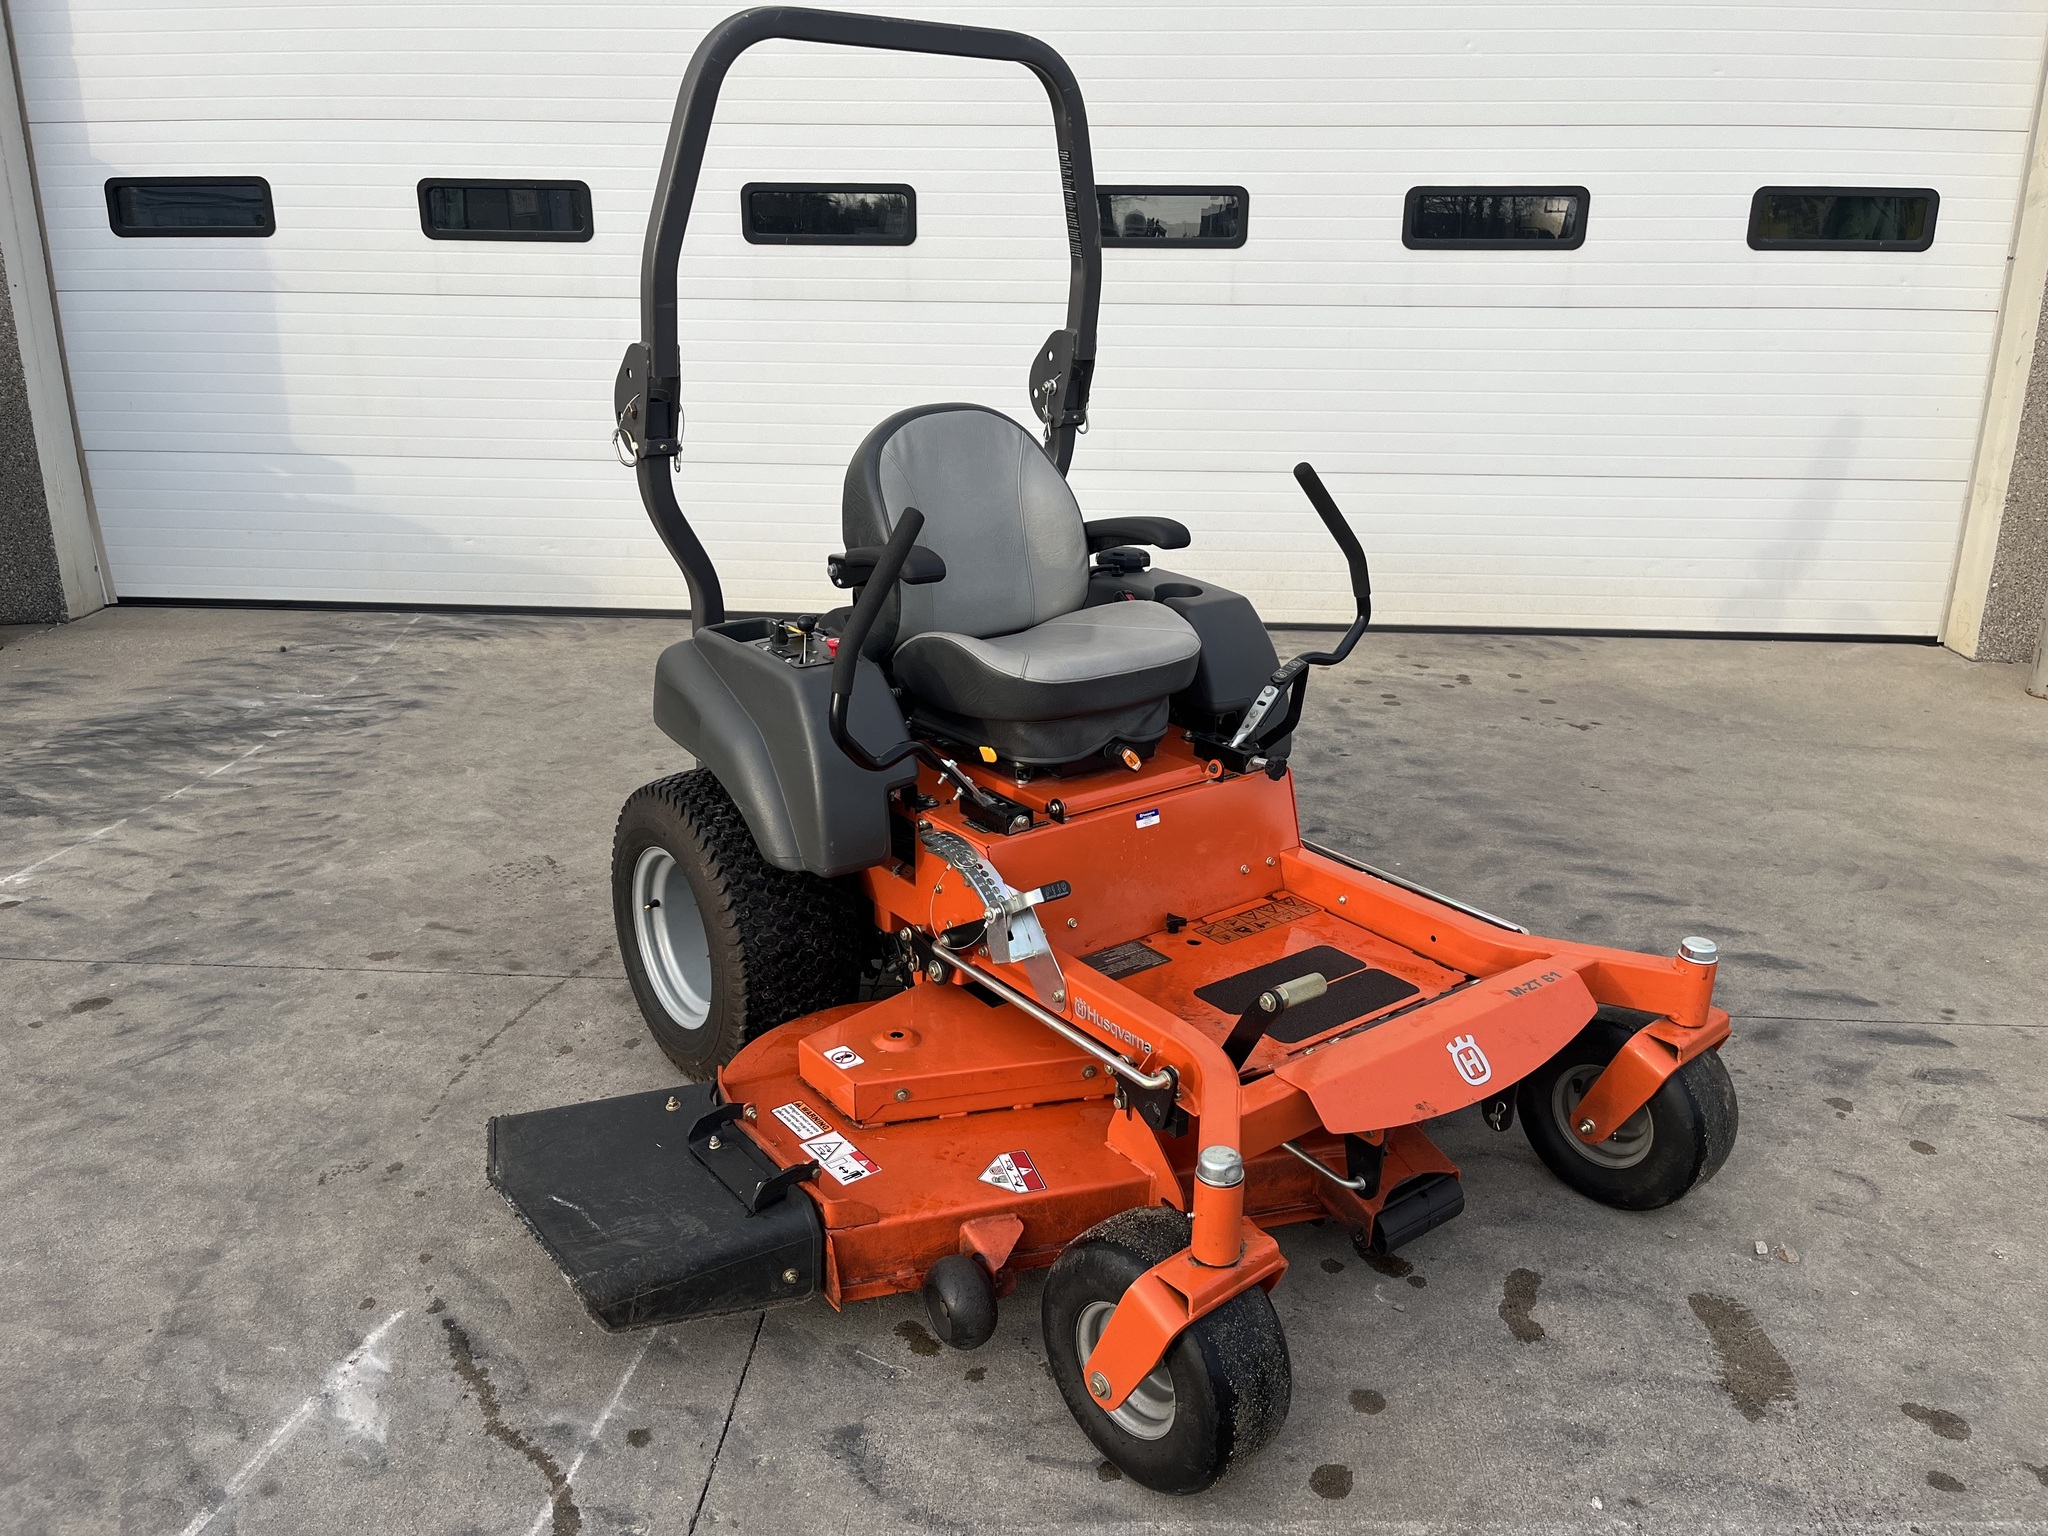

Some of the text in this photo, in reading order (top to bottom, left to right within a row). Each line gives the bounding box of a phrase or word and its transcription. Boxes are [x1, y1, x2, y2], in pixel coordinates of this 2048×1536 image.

[1507, 970, 1563, 997] M-ZT 61
[1087, 1006, 1152, 1054] Husqvarna
[801, 1106, 830, 1130] WARNING
